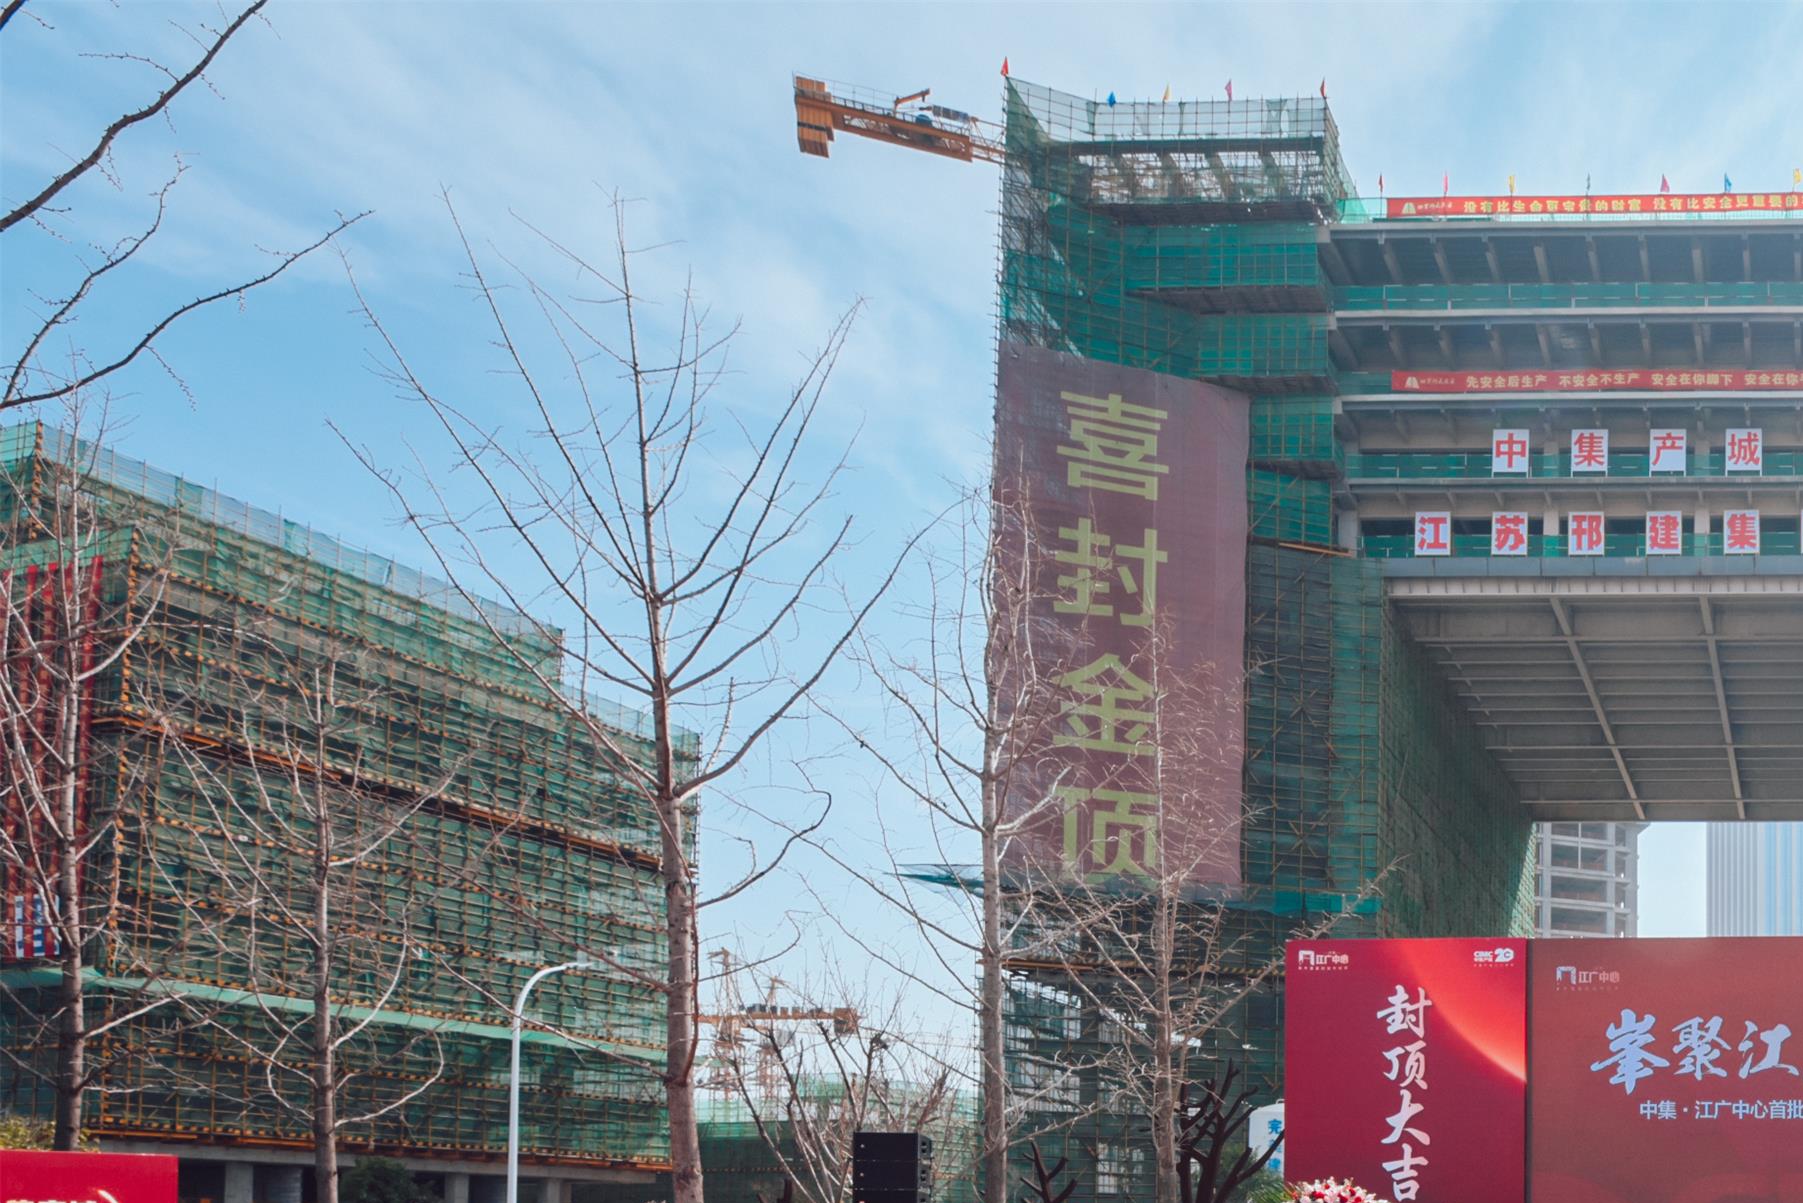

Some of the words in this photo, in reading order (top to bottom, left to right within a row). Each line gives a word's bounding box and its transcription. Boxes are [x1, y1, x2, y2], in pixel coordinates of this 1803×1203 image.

[1466, 374, 1548, 389] 先安全后生产
[1559, 373, 1641, 388] 不安全不生产
[1494, 431, 1762, 470] 中集产城
[1047, 390, 1170, 888] 喜封金顶
[1376, 984, 1434, 1202] 封顶大吉
